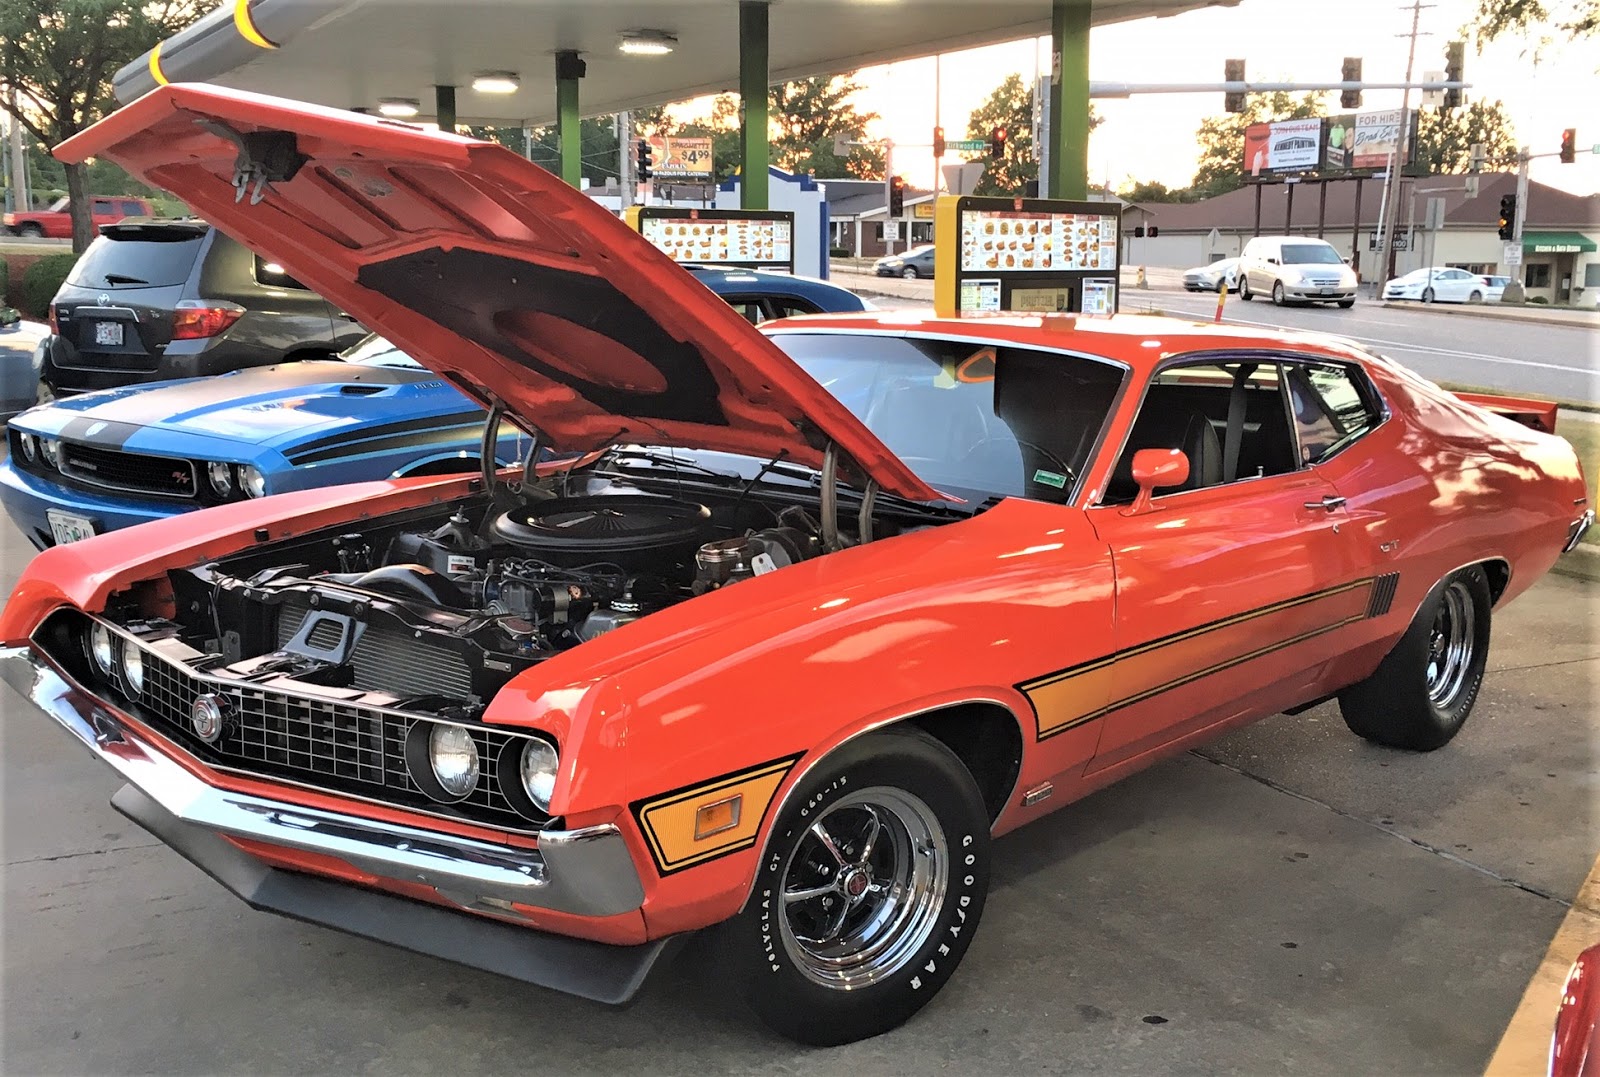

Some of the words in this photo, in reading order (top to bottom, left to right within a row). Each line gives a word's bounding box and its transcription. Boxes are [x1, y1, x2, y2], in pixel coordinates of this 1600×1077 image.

[1359, 115, 1377, 125] FOR
[801, 776, 847, 817] G60-15
[770, 853, 780, 872] GT
[762, 889, 780, 972] POLYGLAS
[910, 835, 975, 990] GOODYEAR
